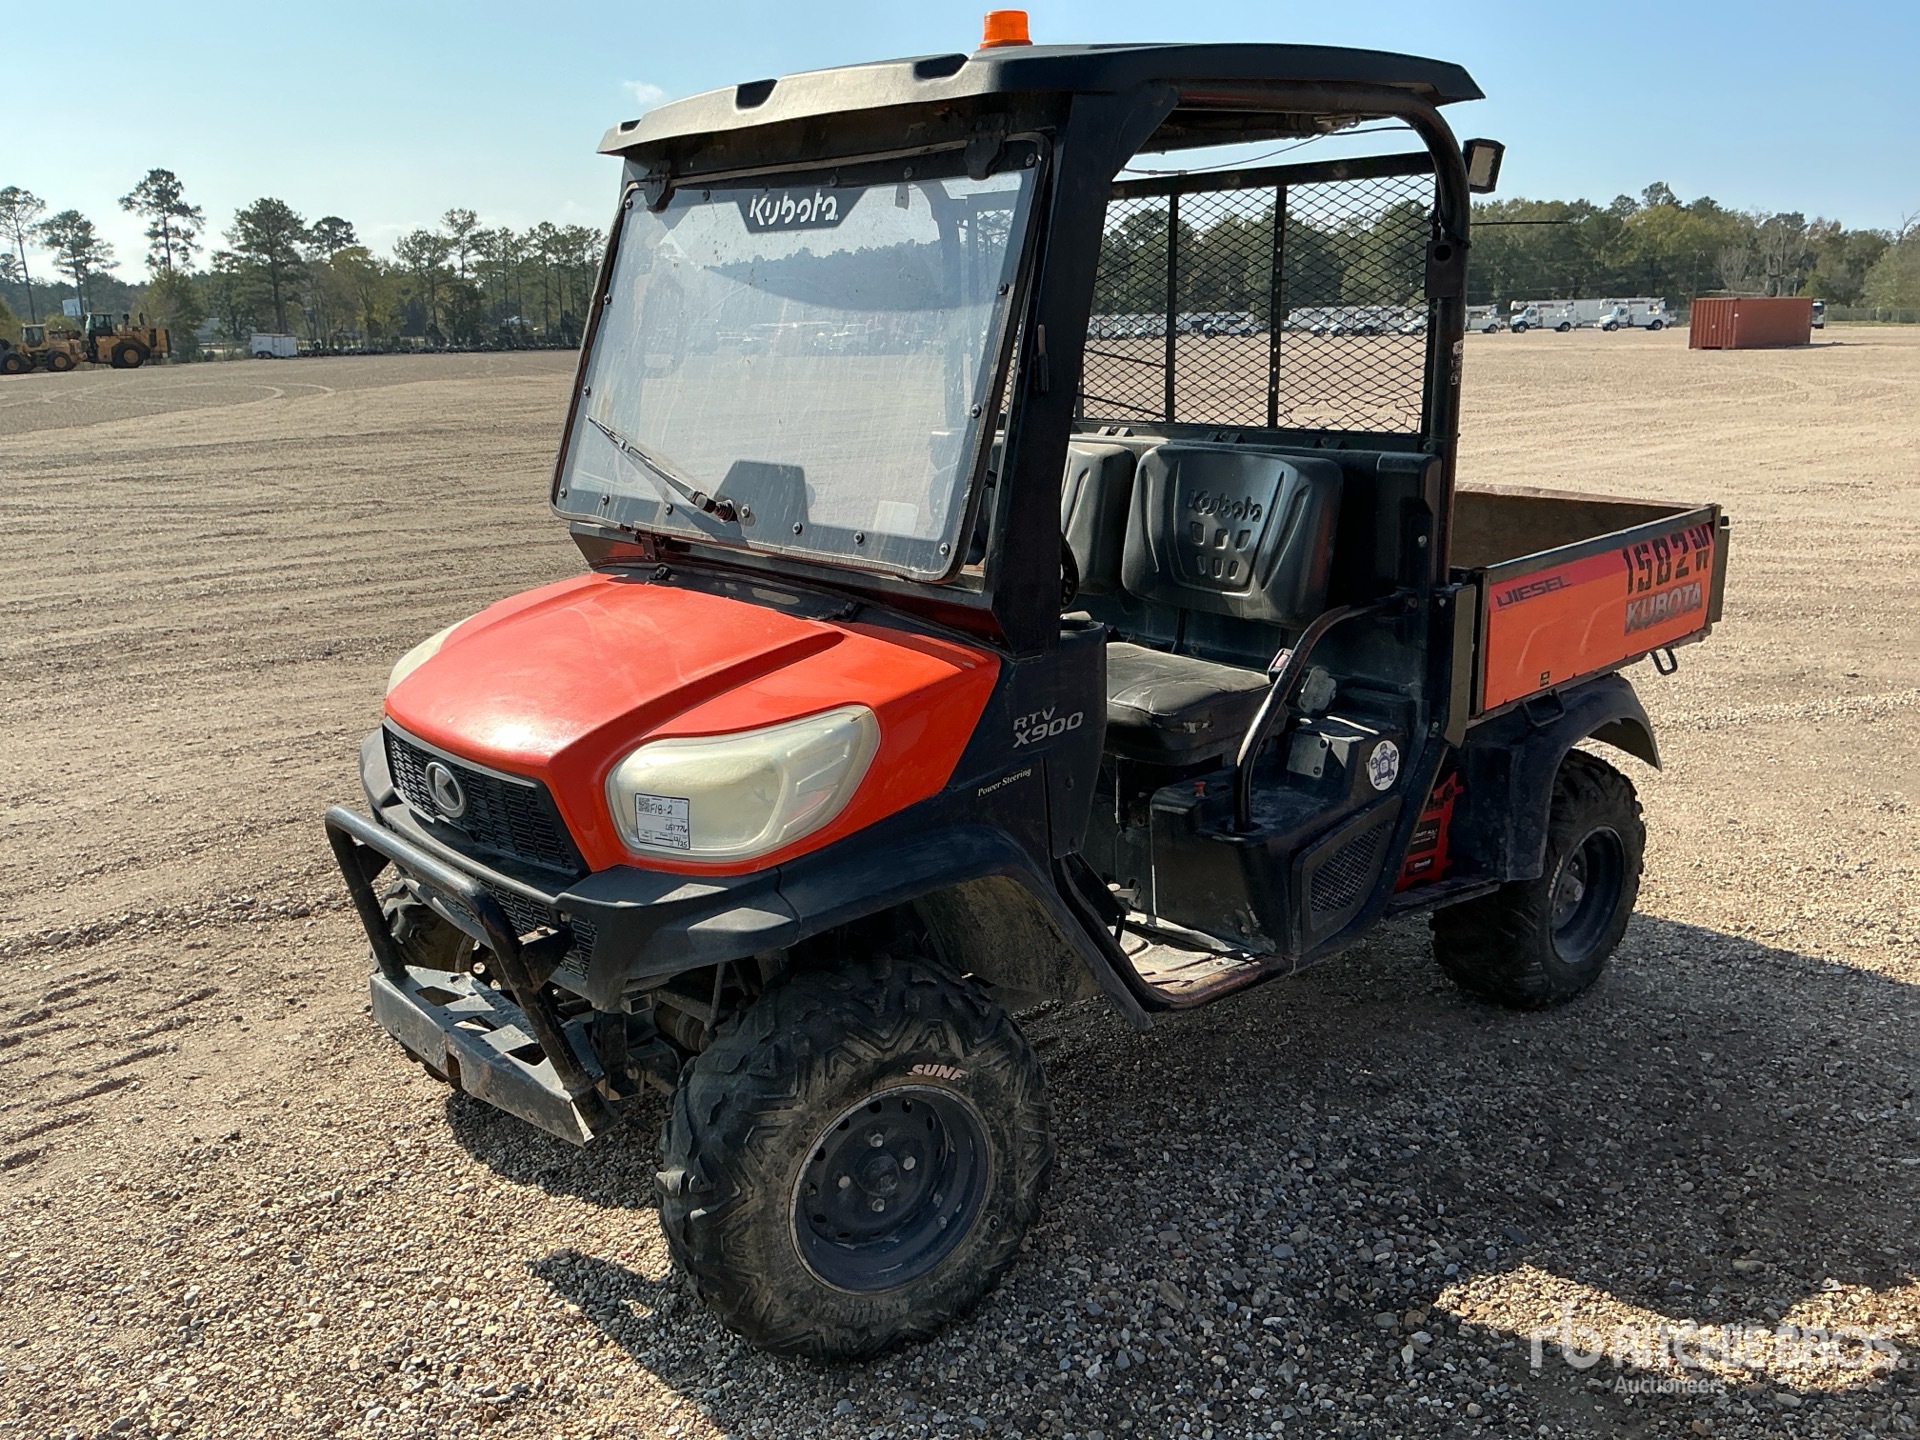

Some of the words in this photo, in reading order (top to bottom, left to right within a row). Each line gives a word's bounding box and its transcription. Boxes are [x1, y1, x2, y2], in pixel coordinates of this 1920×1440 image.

[750, 189, 838, 226] Kubota
[1188, 489, 1263, 523] Kubota
[1625, 581, 1702, 635] KUBOTA
[1012, 711, 1084, 749] X900
[1013, 706, 1055, 730] RTV
[977, 780, 1002, 797] Power
[1002, 768, 1032, 786] Steering
[907, 1063, 969, 1081] SUNF
